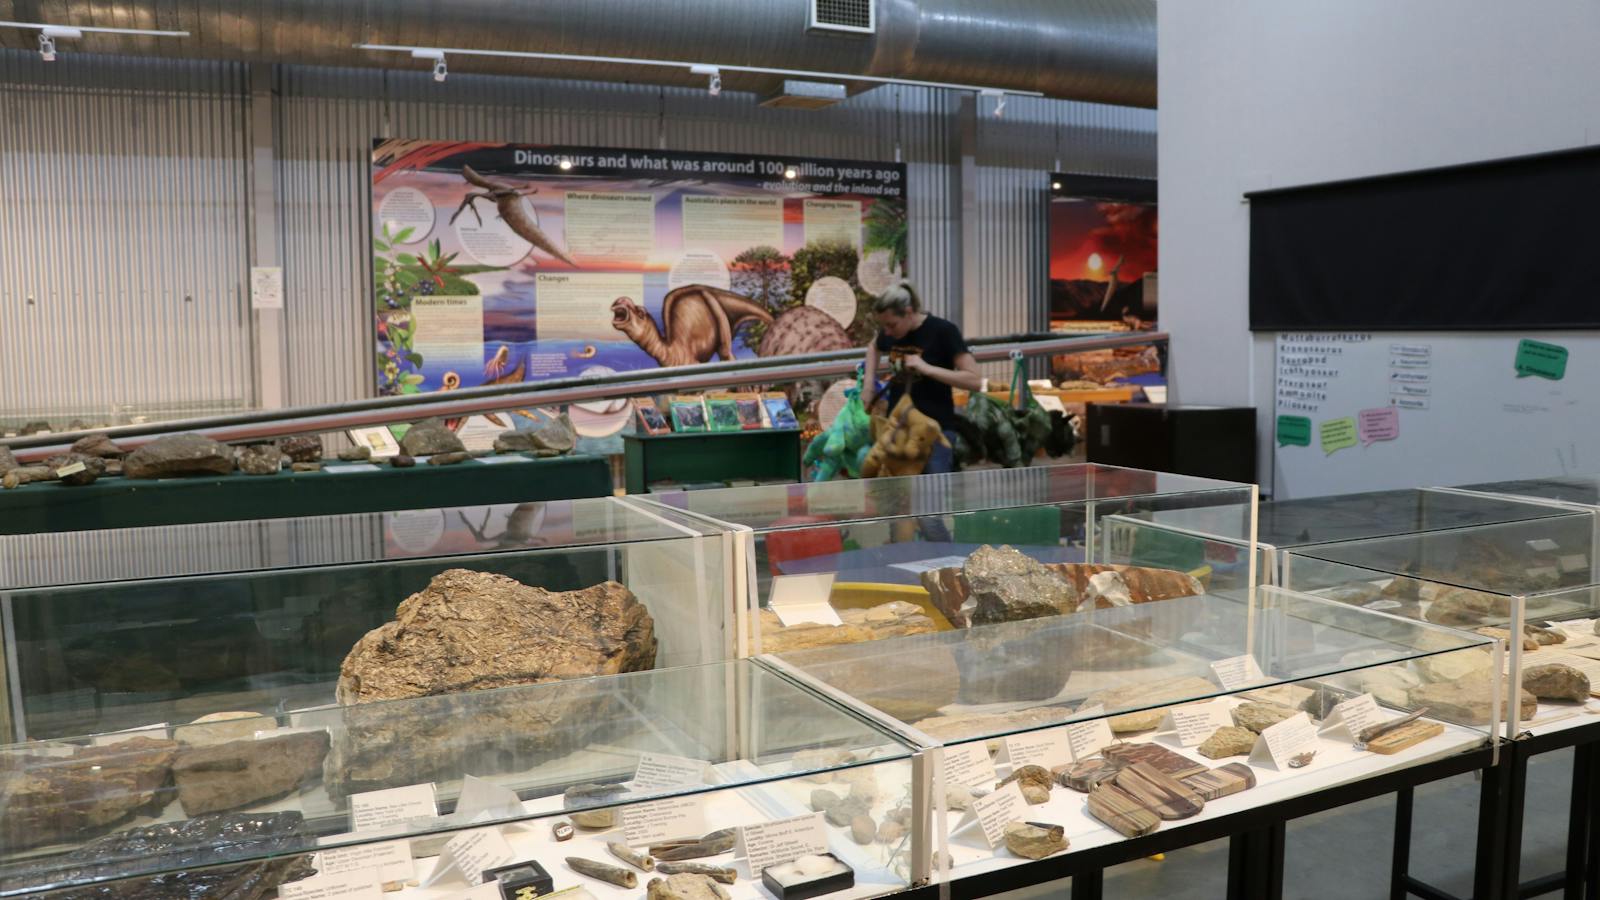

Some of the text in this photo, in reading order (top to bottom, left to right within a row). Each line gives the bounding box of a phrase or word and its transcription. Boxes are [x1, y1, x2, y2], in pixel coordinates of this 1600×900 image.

[514, 150, 594, 168] Dinosaurs
[597, 154, 627, 169] and
[629, 155, 668, 170] what
[671, 159, 700, 171] was
[703, 159, 755, 173] around
[759, 161, 783, 175] 100
[837, 167, 873, 182] years
[875, 168, 901, 184] ago
[763, 181, 811, 193] evolution
[813, 182, 832, 193] and
[834, 182, 851, 193] the
[852, 183, 882, 195] inland
[884, 186, 901, 196] sea
[567, 192, 590, 201] Where
[591, 193, 625, 202] dinosaurs
[415, 298, 467, 307] Modern times
